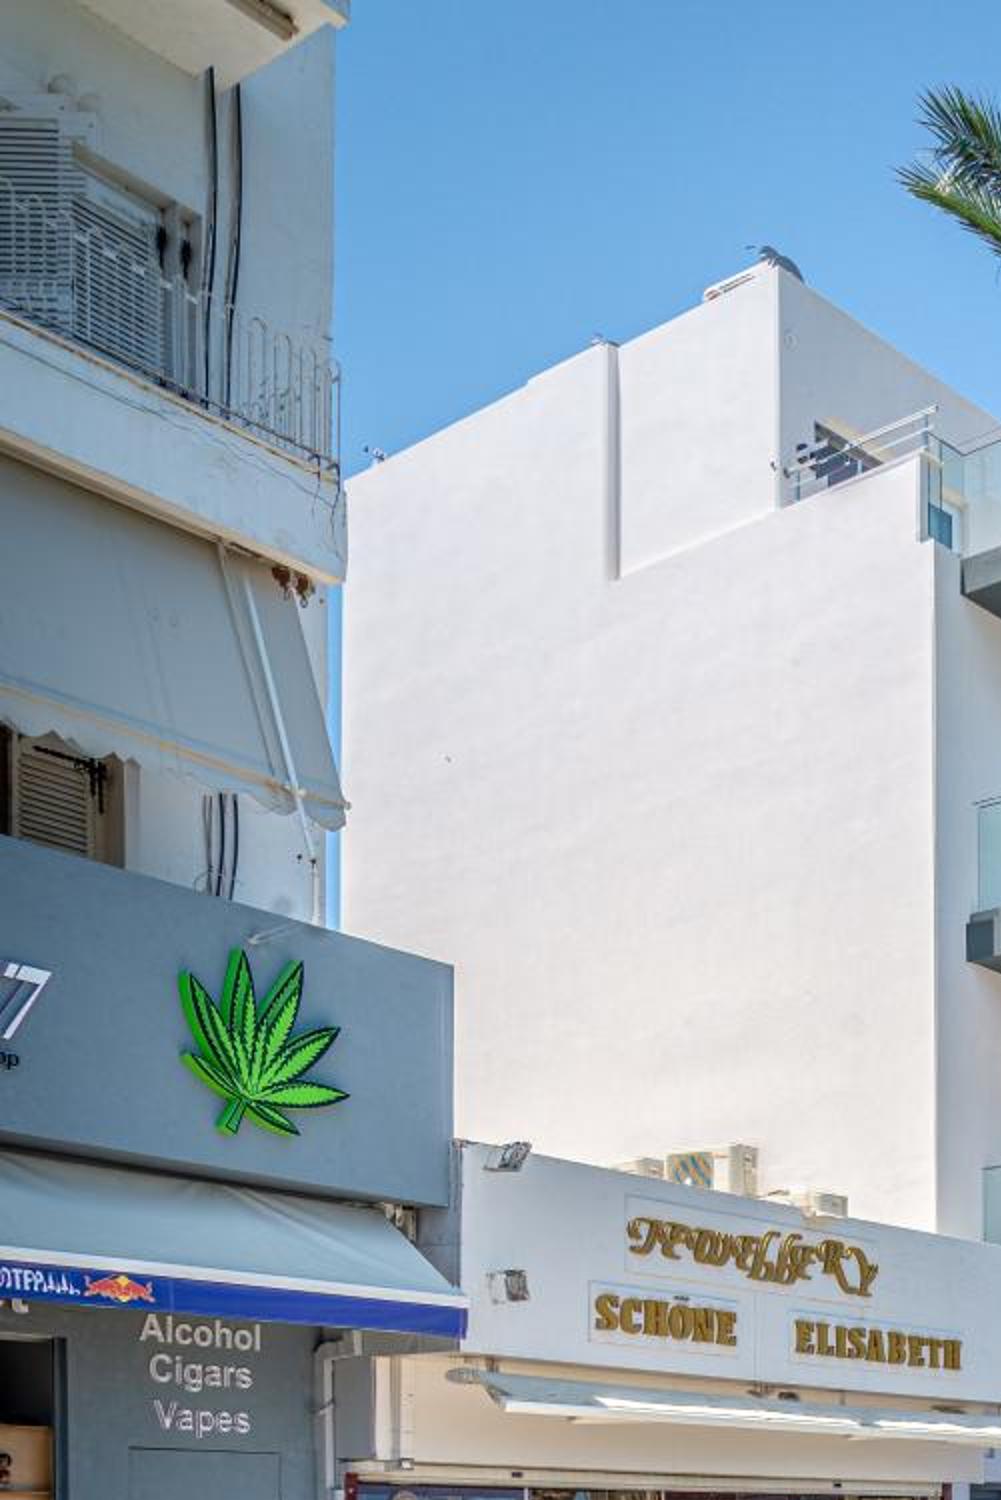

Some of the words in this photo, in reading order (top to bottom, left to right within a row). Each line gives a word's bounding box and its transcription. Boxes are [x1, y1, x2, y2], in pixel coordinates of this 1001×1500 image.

[140, 1313, 261, 1352] Alcohol
[594, 1295, 738, 1347] SCHÖNE
[794, 1318, 963, 1371] ELISABETH
[149, 1353, 253, 1393] Cigars
[153, 1399, 251, 1439] Vapes
